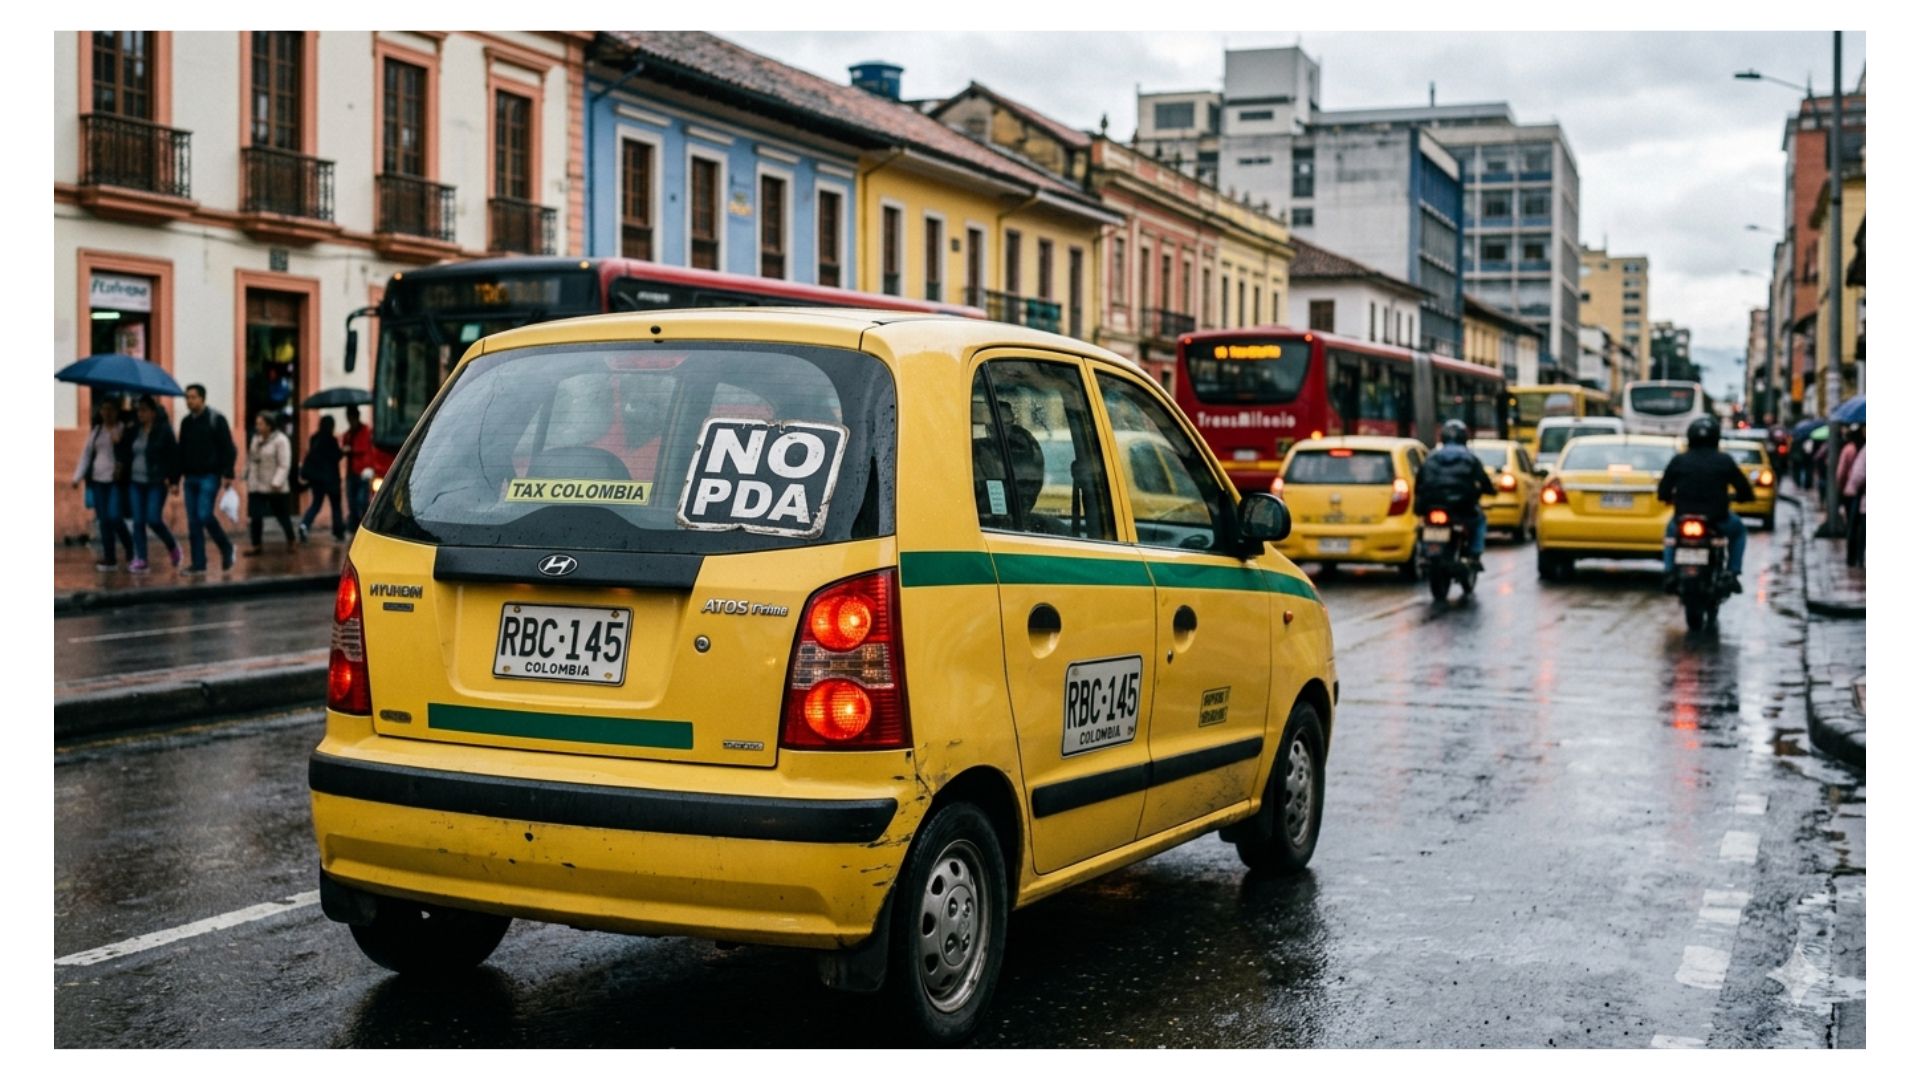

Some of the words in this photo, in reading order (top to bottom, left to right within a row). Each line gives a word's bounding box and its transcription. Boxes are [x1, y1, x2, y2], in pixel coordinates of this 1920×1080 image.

[704, 428, 826, 479] NO
[513, 483, 546, 498] TAX
[550, 483, 644, 501] COLOMBIA
[692, 478, 811, 524] PDA
[701, 599, 749, 616] ATOS
[525, 661, 590, 677] COLOMBIA
[1080, 725, 1121, 745] COLOMBIA
